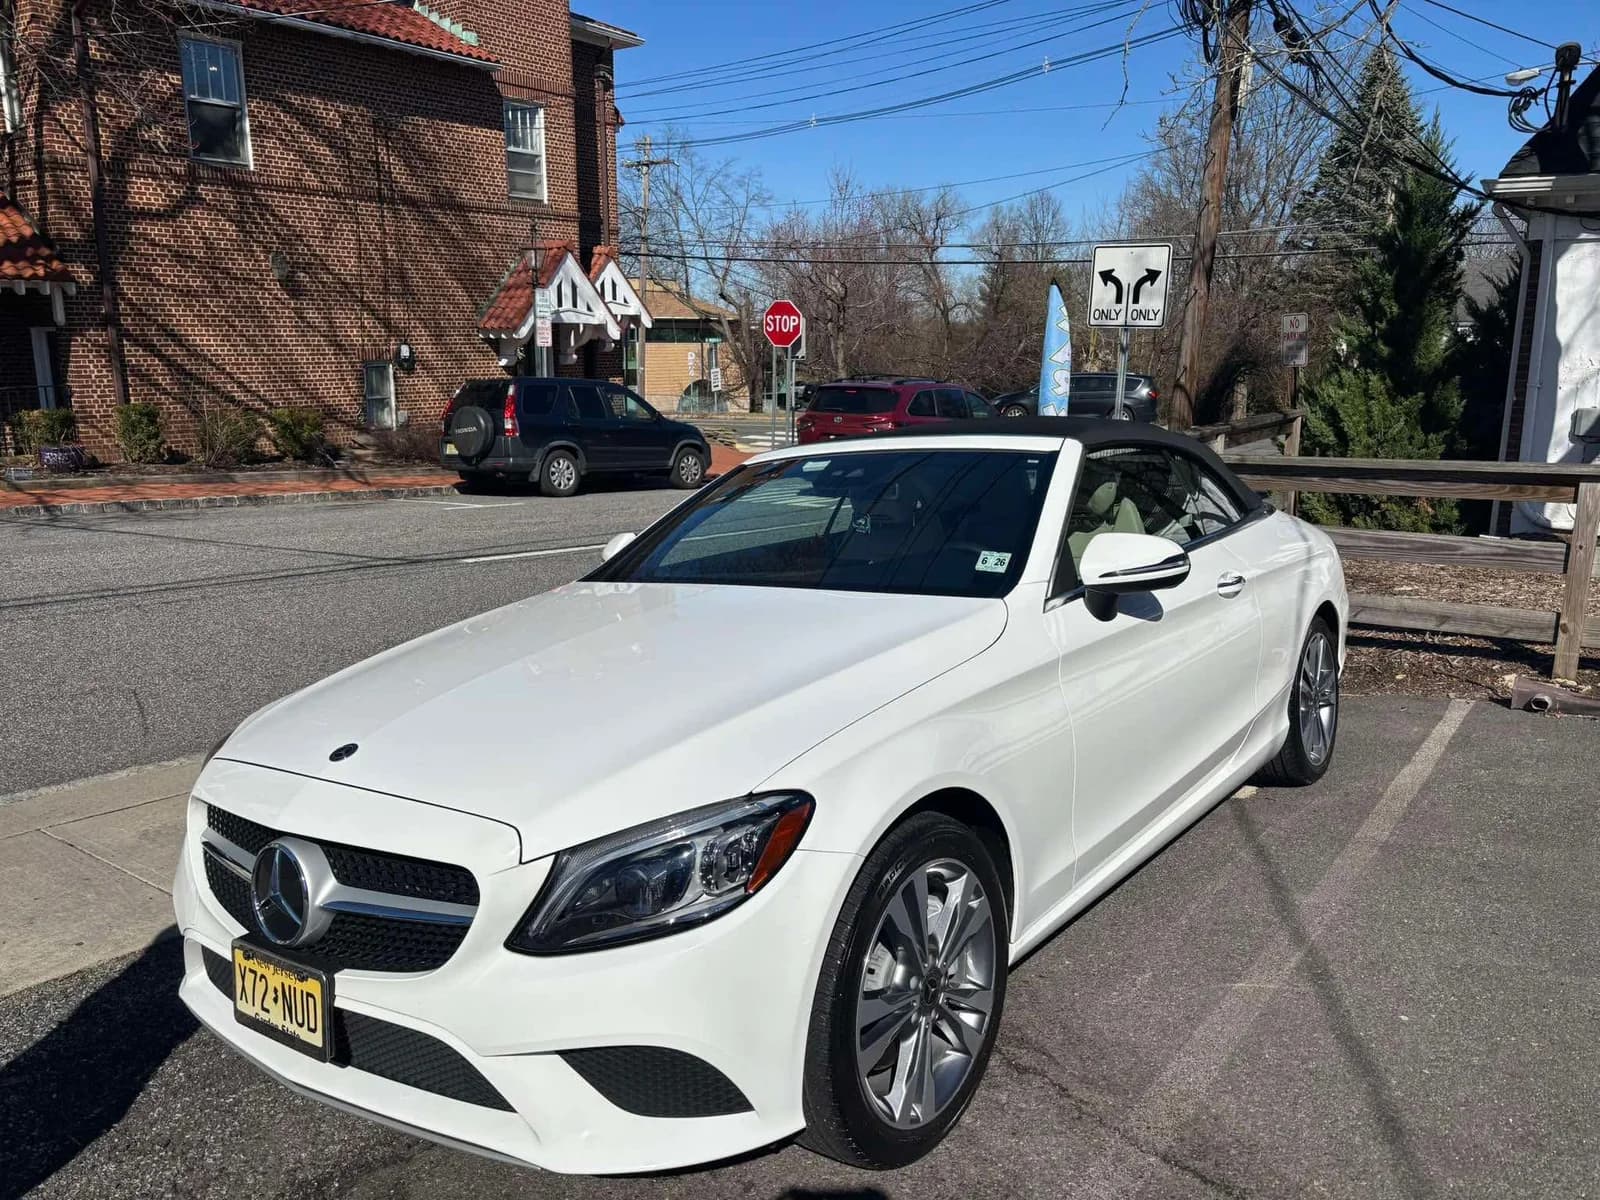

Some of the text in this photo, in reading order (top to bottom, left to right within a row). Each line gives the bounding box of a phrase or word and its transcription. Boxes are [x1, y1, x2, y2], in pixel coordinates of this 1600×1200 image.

[1093, 308, 1160, 321] ONLY ONLY
[766, 315, 799, 332] STOP
[1289, 319, 1300, 329] NO
[455, 426, 478, 434] HONDA
[981, 557, 1006, 566] 6 26
[272, 964, 299, 984] Jersey
[238, 963, 317, 1034] X72 NUD
